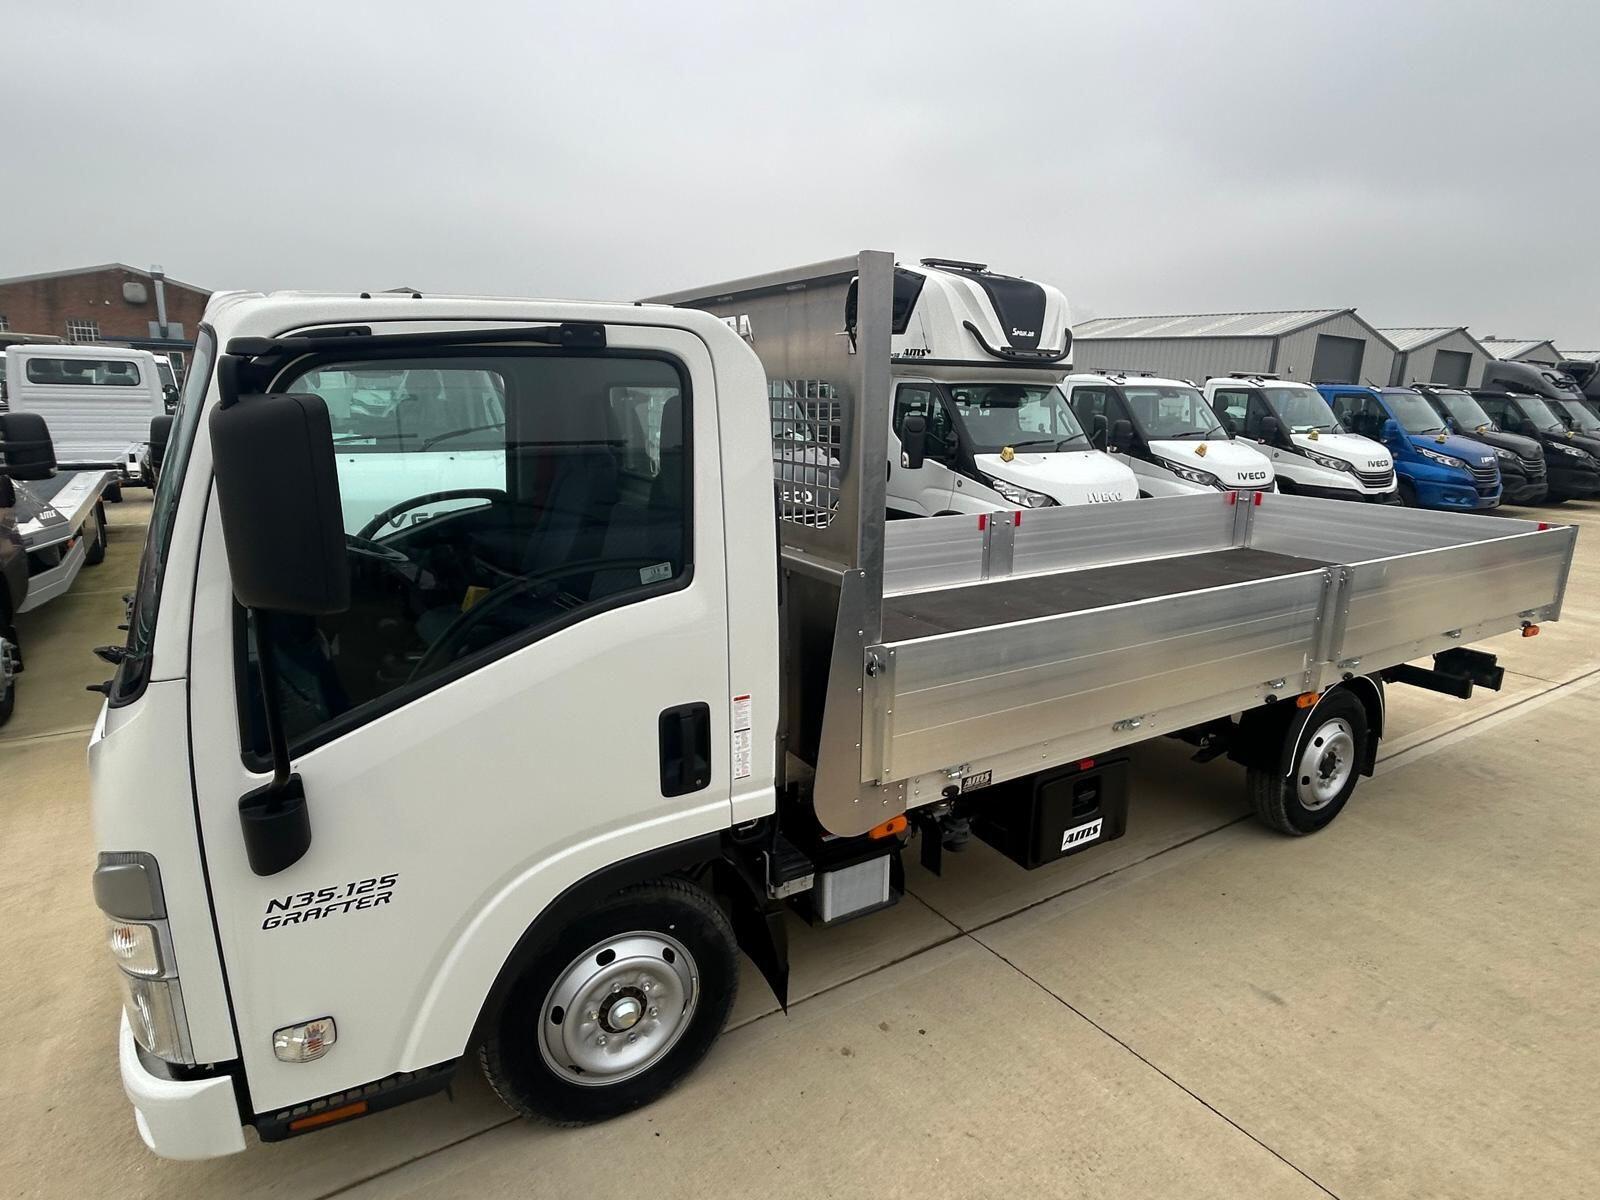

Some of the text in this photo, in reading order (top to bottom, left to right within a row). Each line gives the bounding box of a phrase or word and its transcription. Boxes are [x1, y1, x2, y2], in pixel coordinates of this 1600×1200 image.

[1367, 460, 1389, 468] IVECO
[1237, 471, 1266, 480] IVECO
[1086, 490, 1122, 503] IVECO
[265, 873, 399, 914] N35.125
[262, 891, 393, 930] GRAFTER
